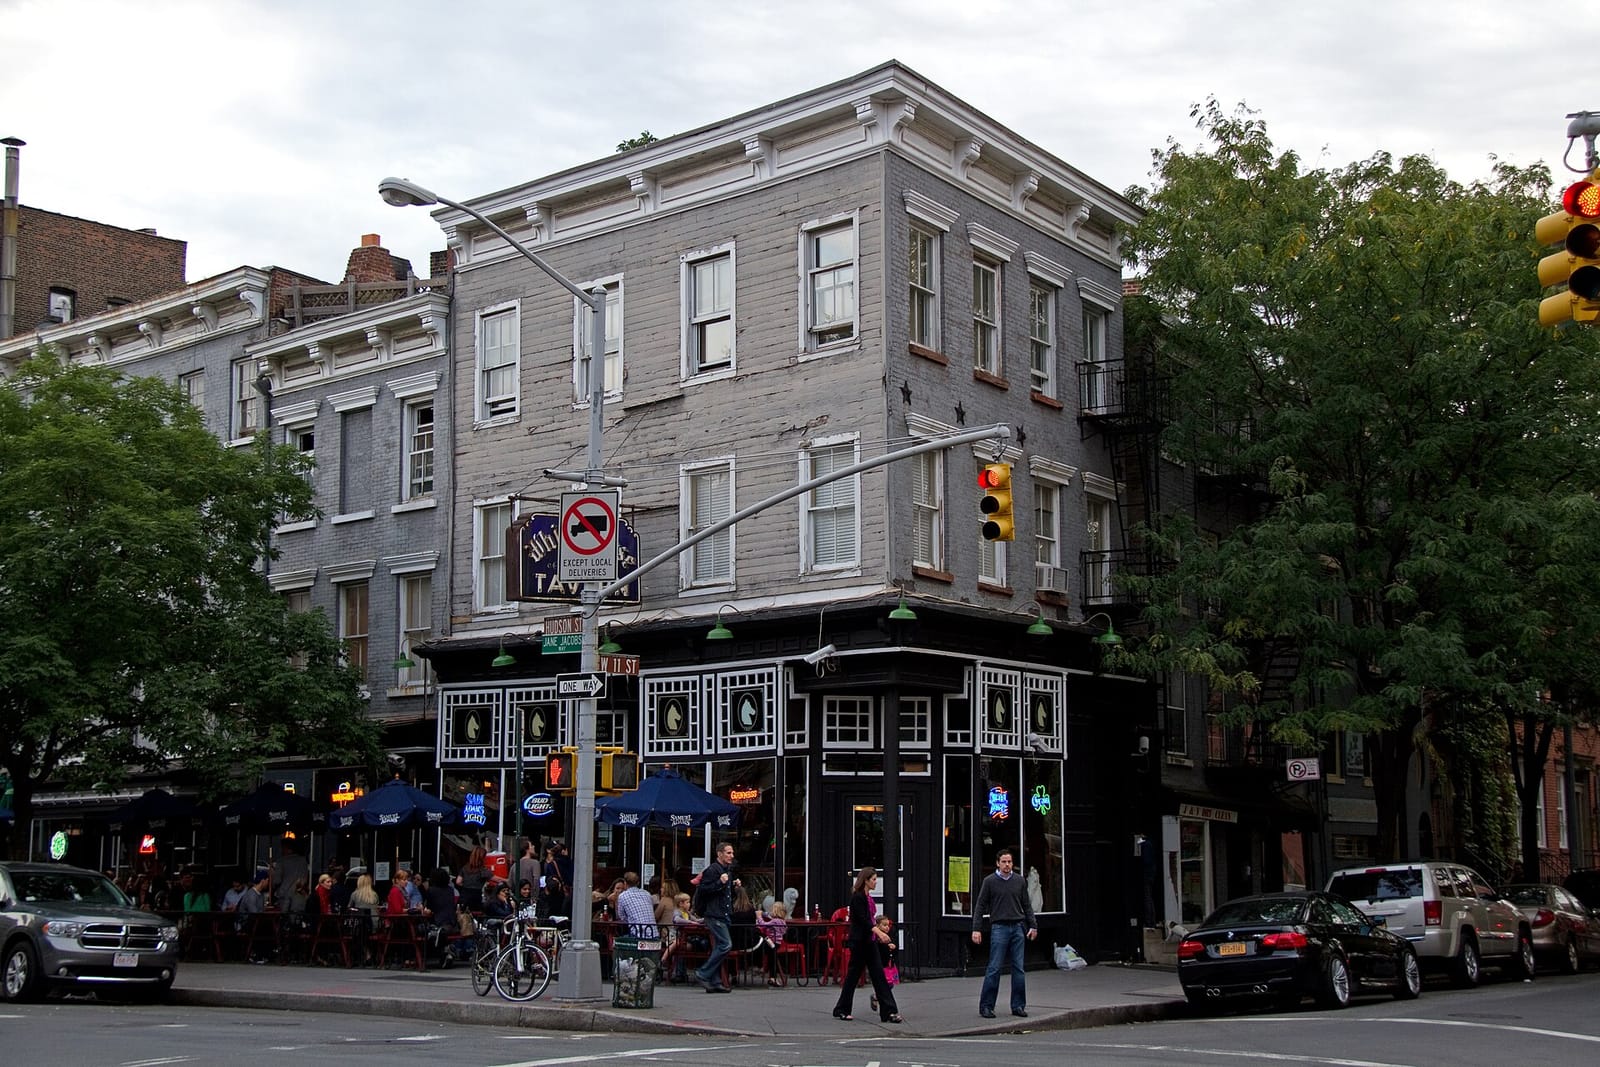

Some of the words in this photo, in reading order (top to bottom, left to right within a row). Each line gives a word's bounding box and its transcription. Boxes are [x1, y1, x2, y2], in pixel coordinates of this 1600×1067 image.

[563, 559, 588, 567] EXCEPT
[591, 558, 613, 567] LOCAL
[568, 568, 607, 577] DELIVERIES
[545, 618, 572, 635] HUDSON
[543, 636, 559, 647] JANE
[560, 635, 582, 646] JACOBS
[600, 657, 609, 672] W
[613, 658, 621, 673] 11
[625, 659, 637, 674] ST
[562, 681, 577, 692] ONE
[583, 680, 599, 691] WAY
[465, 793, 485, 805] SAM
[463, 804, 485, 815] ADAMS
[619, 812, 639, 820] SAMUEL
